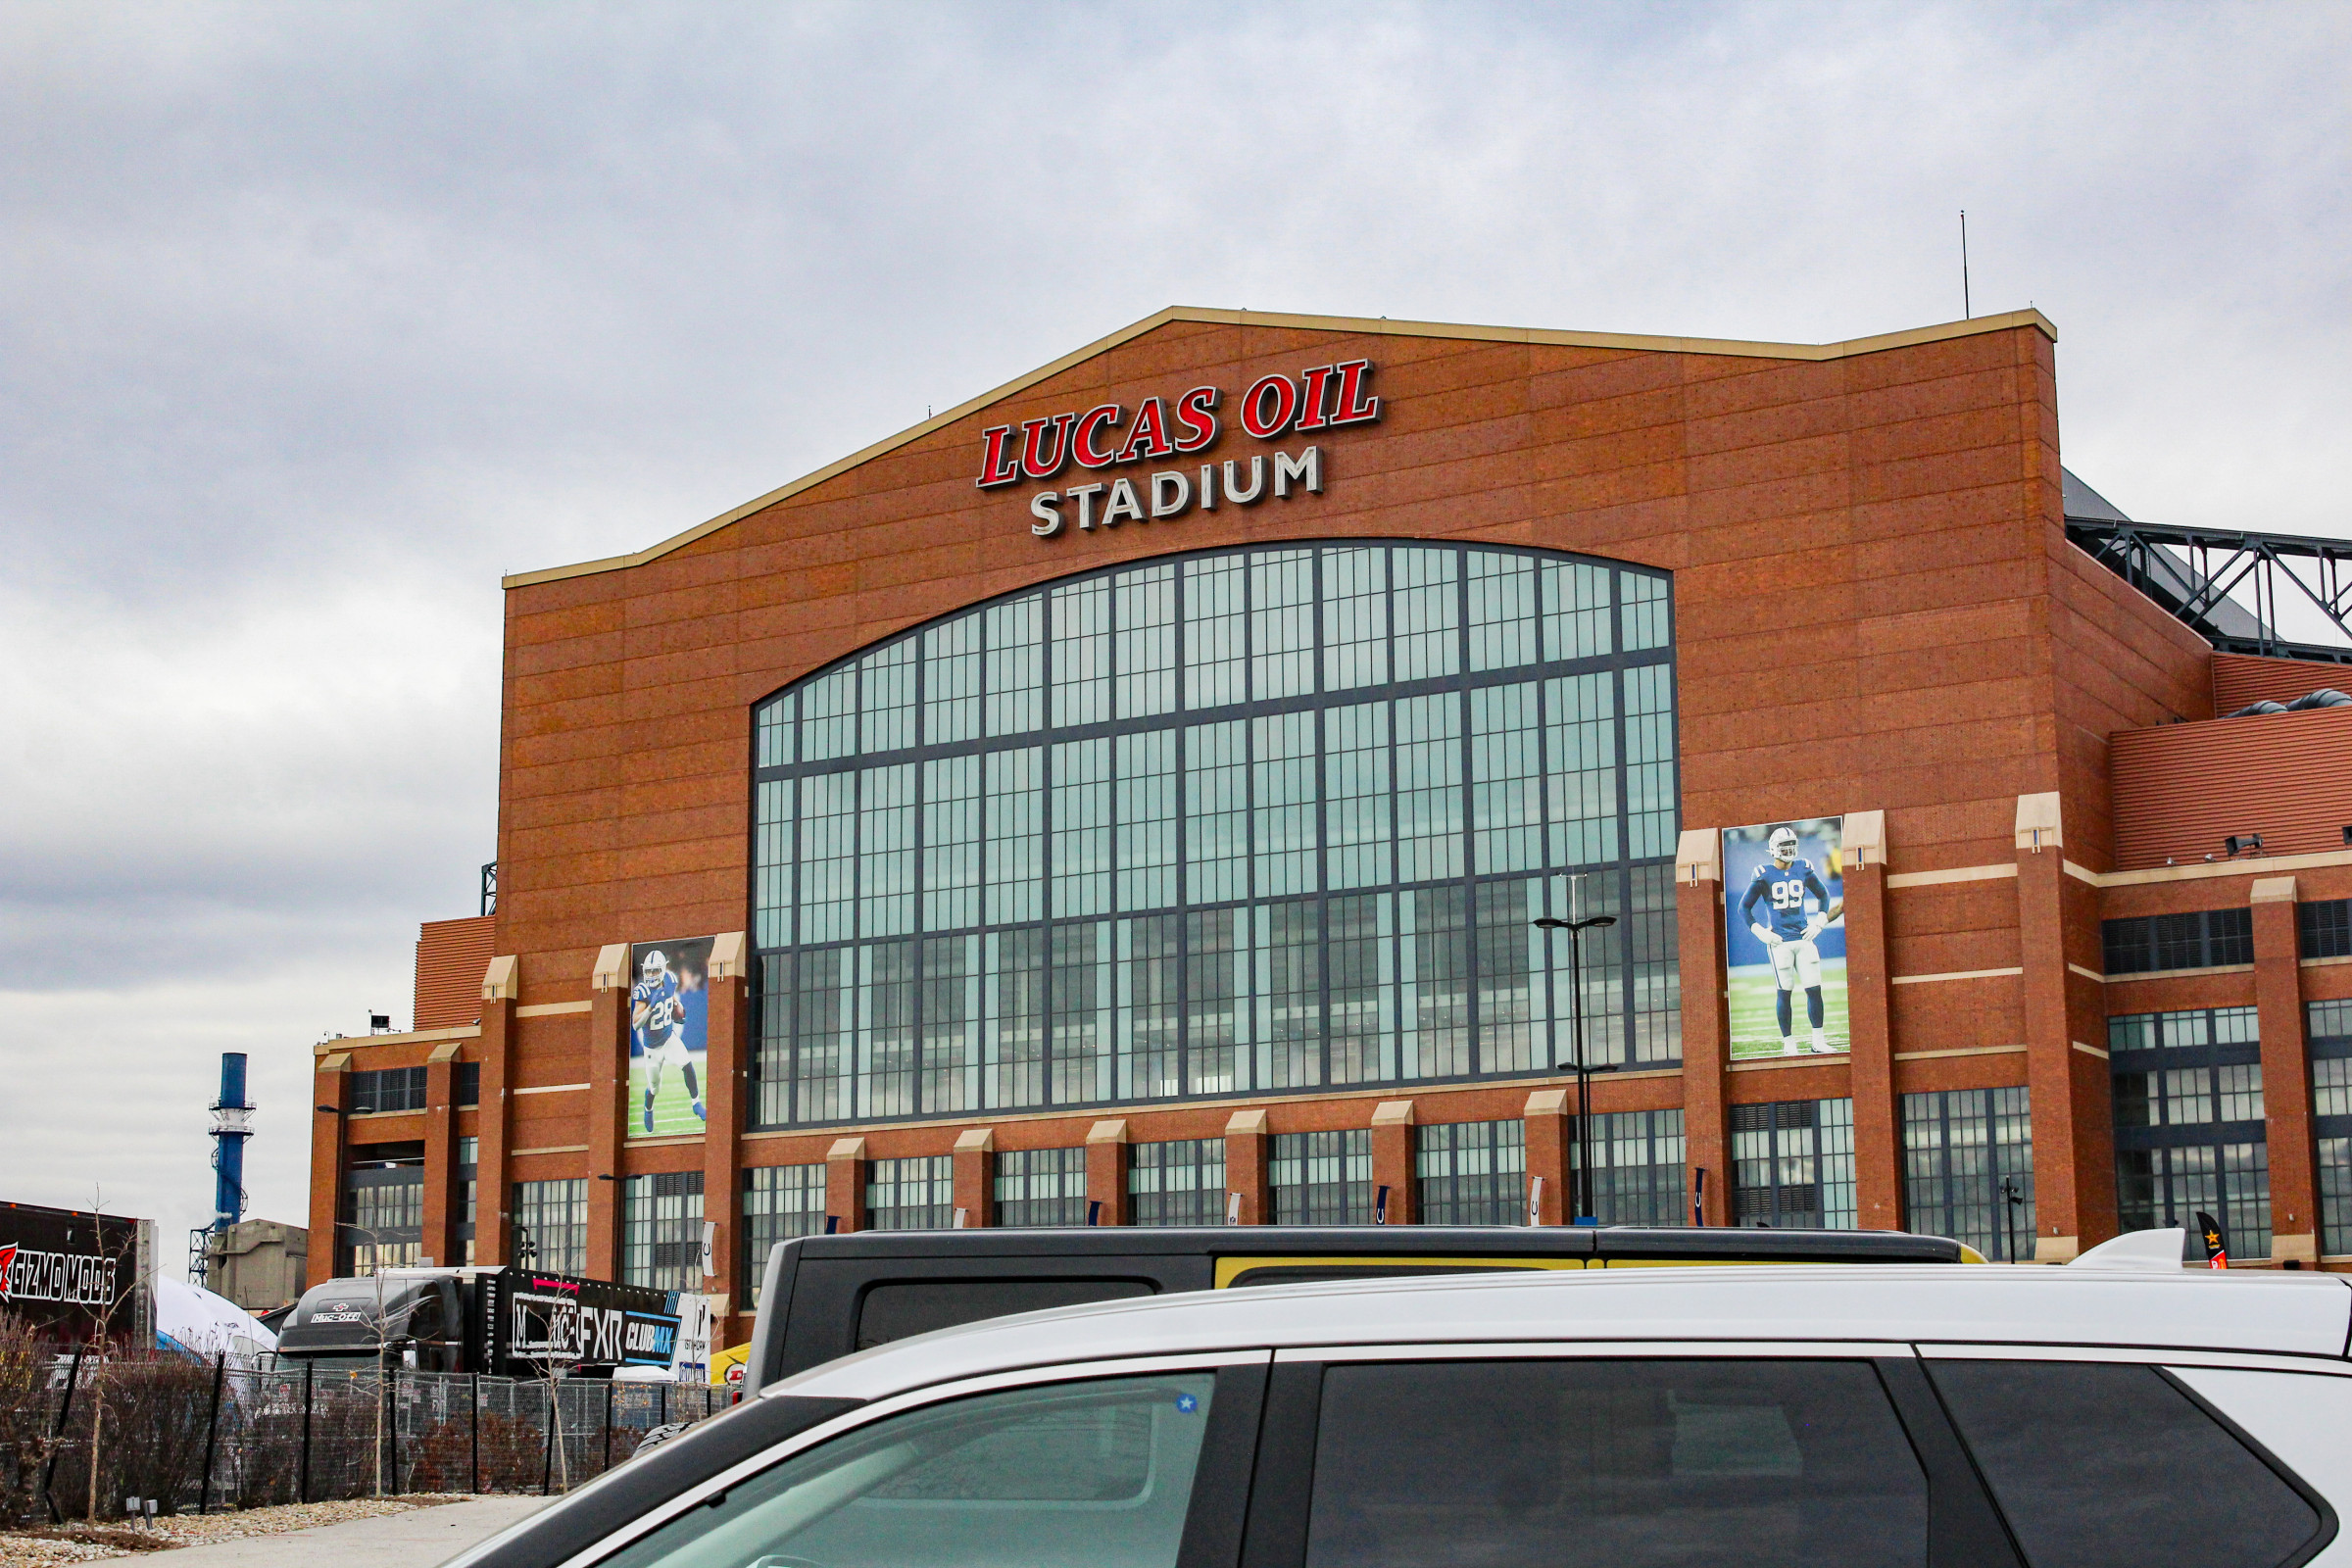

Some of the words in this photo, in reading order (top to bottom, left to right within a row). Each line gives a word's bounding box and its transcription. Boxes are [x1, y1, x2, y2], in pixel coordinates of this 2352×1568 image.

[976, 385, 1221, 488] LUCAS
[1240, 358, 1381, 439] OIL
[1031, 445, 1323, 537] STADIUM
[1771, 879, 1804, 910] 99
[650, 997, 674, 1031] 28
[580, 1306, 622, 1360] FXR
